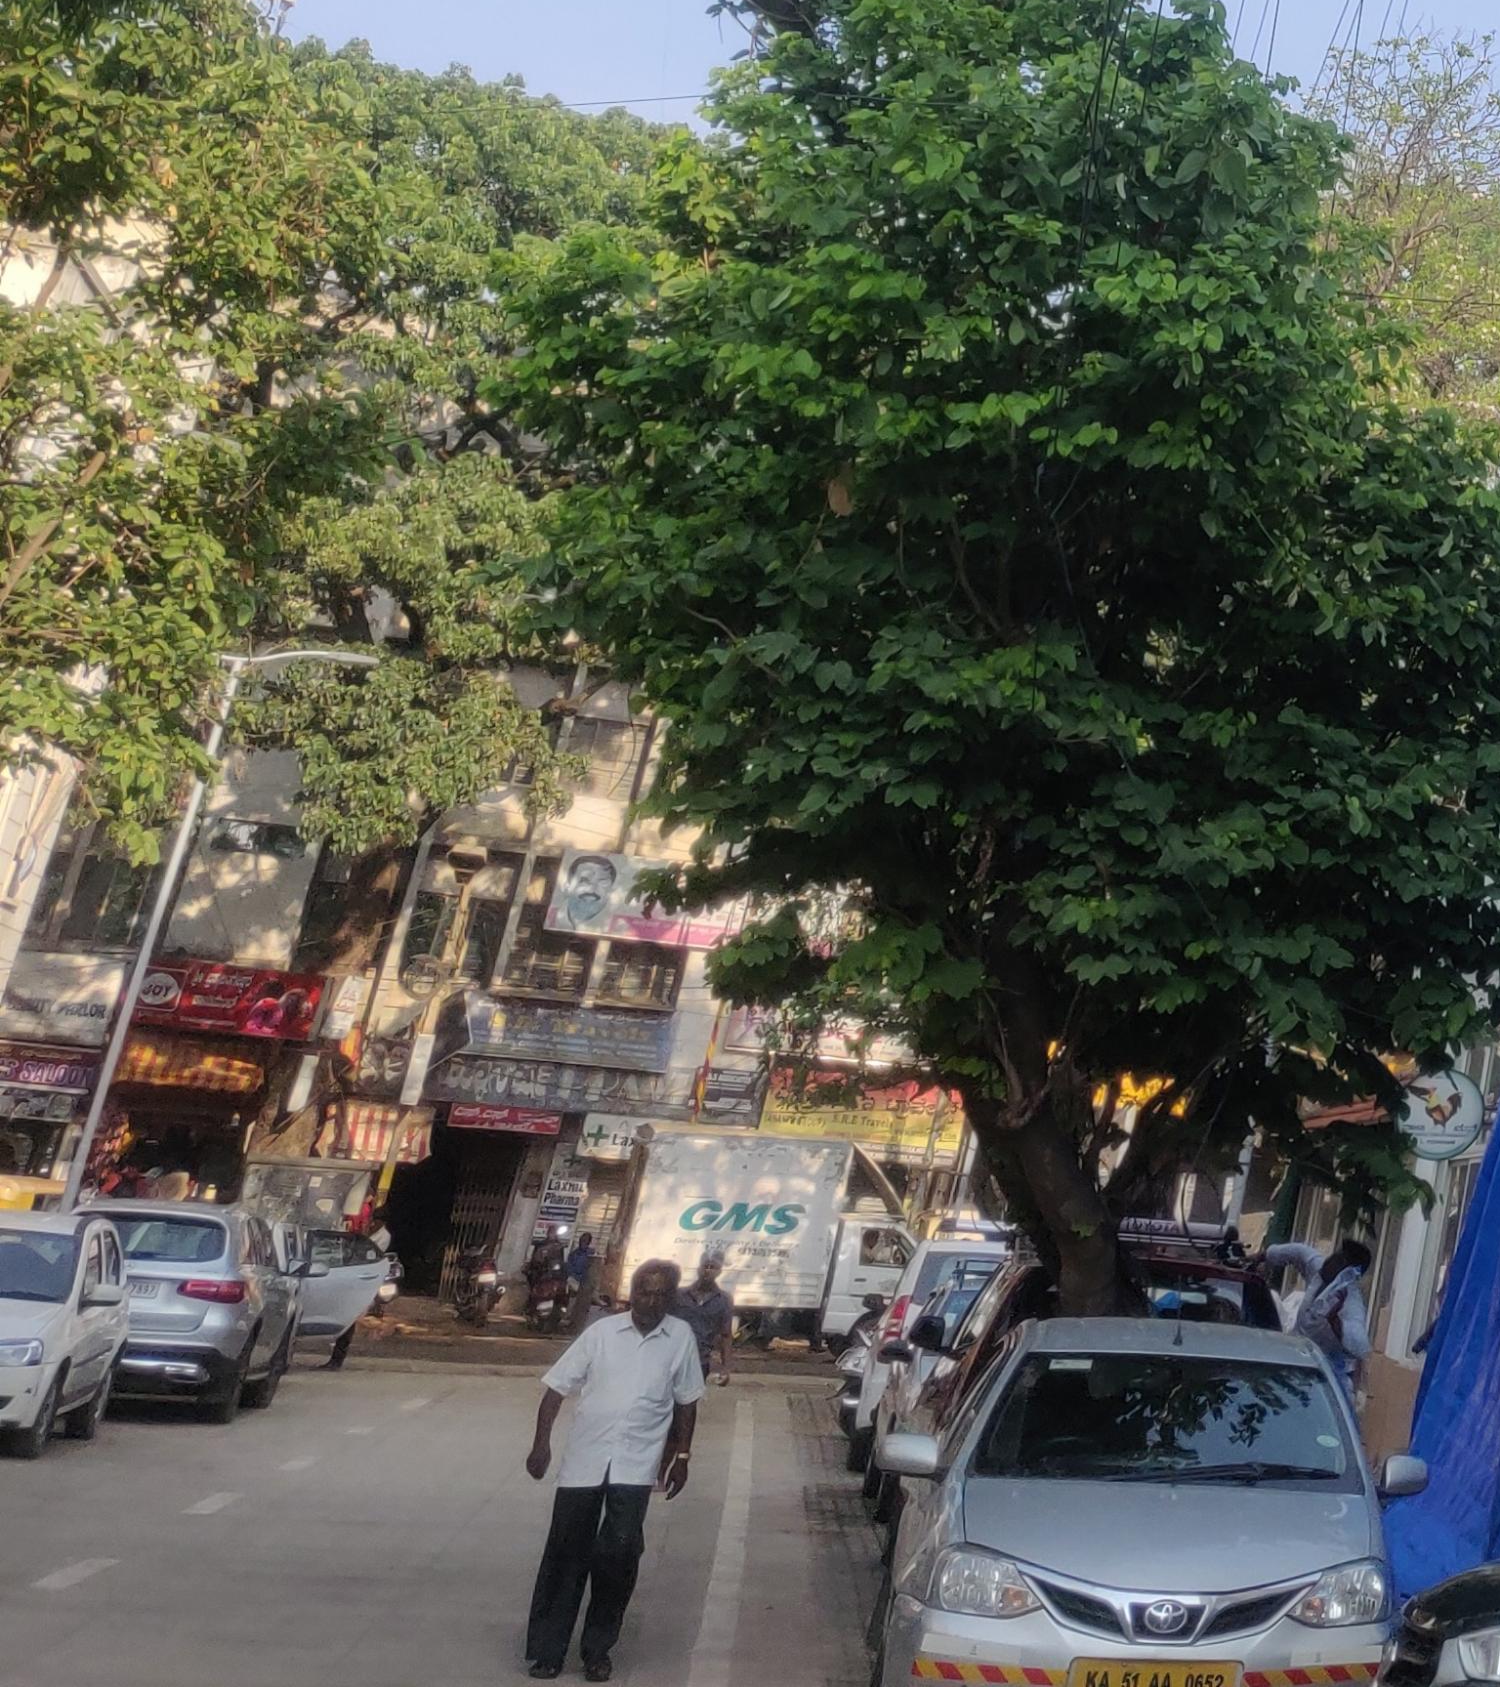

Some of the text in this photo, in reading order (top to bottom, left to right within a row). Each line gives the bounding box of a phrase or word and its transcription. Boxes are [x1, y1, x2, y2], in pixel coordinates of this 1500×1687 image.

[678, 1199, 806, 1235] GMS
[1086, 1671, 1109, 1687] KA
[1121, 1672, 1142, 1687] 51
[1150, 1672, 1172, 1687] AA
